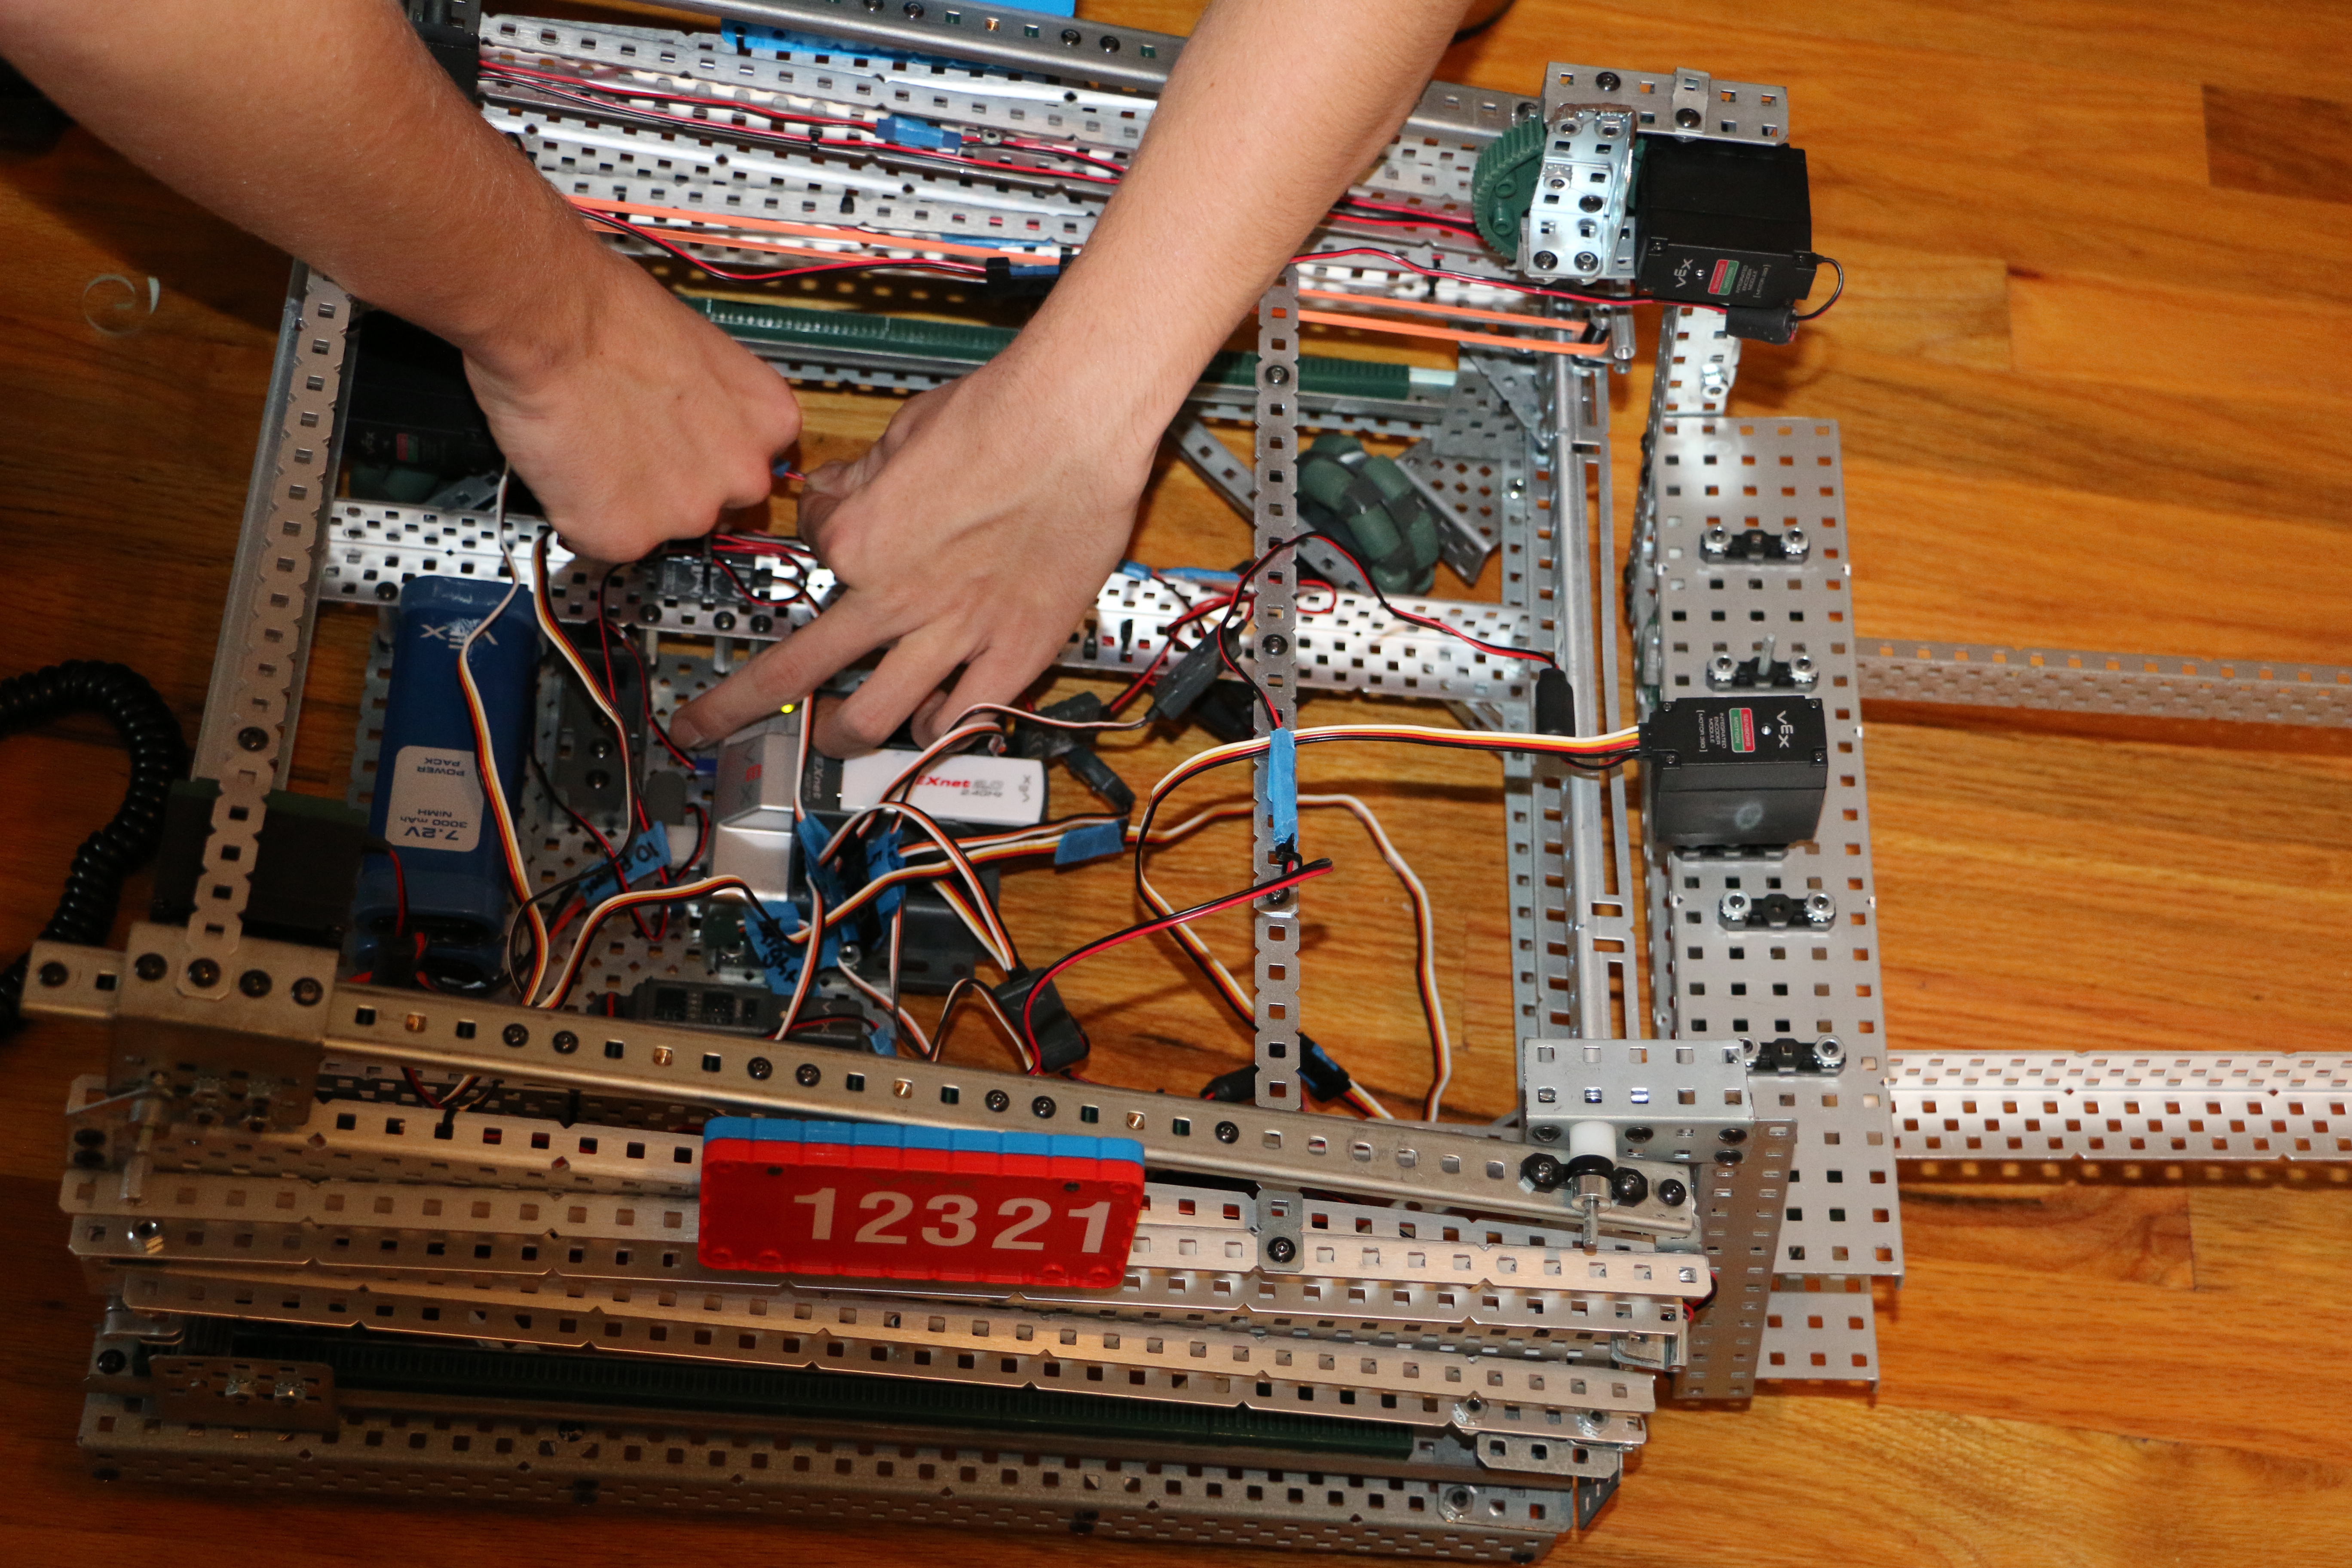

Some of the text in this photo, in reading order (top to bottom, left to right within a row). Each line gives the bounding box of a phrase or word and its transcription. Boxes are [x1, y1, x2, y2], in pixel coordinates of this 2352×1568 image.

[1674, 258, 1693, 288] VEX
[1743, 714, 1751, 746] SENSORS
[1776, 710, 1793, 748] VEX
[425, 757, 460, 767] PACK
[417, 766, 465, 777] POWER
[916, 775, 971, 788] EXnet
[432, 819, 468, 828] 3000
[404, 826, 459, 840] 7.2V
[793, 1187, 1111, 1253] 12321
